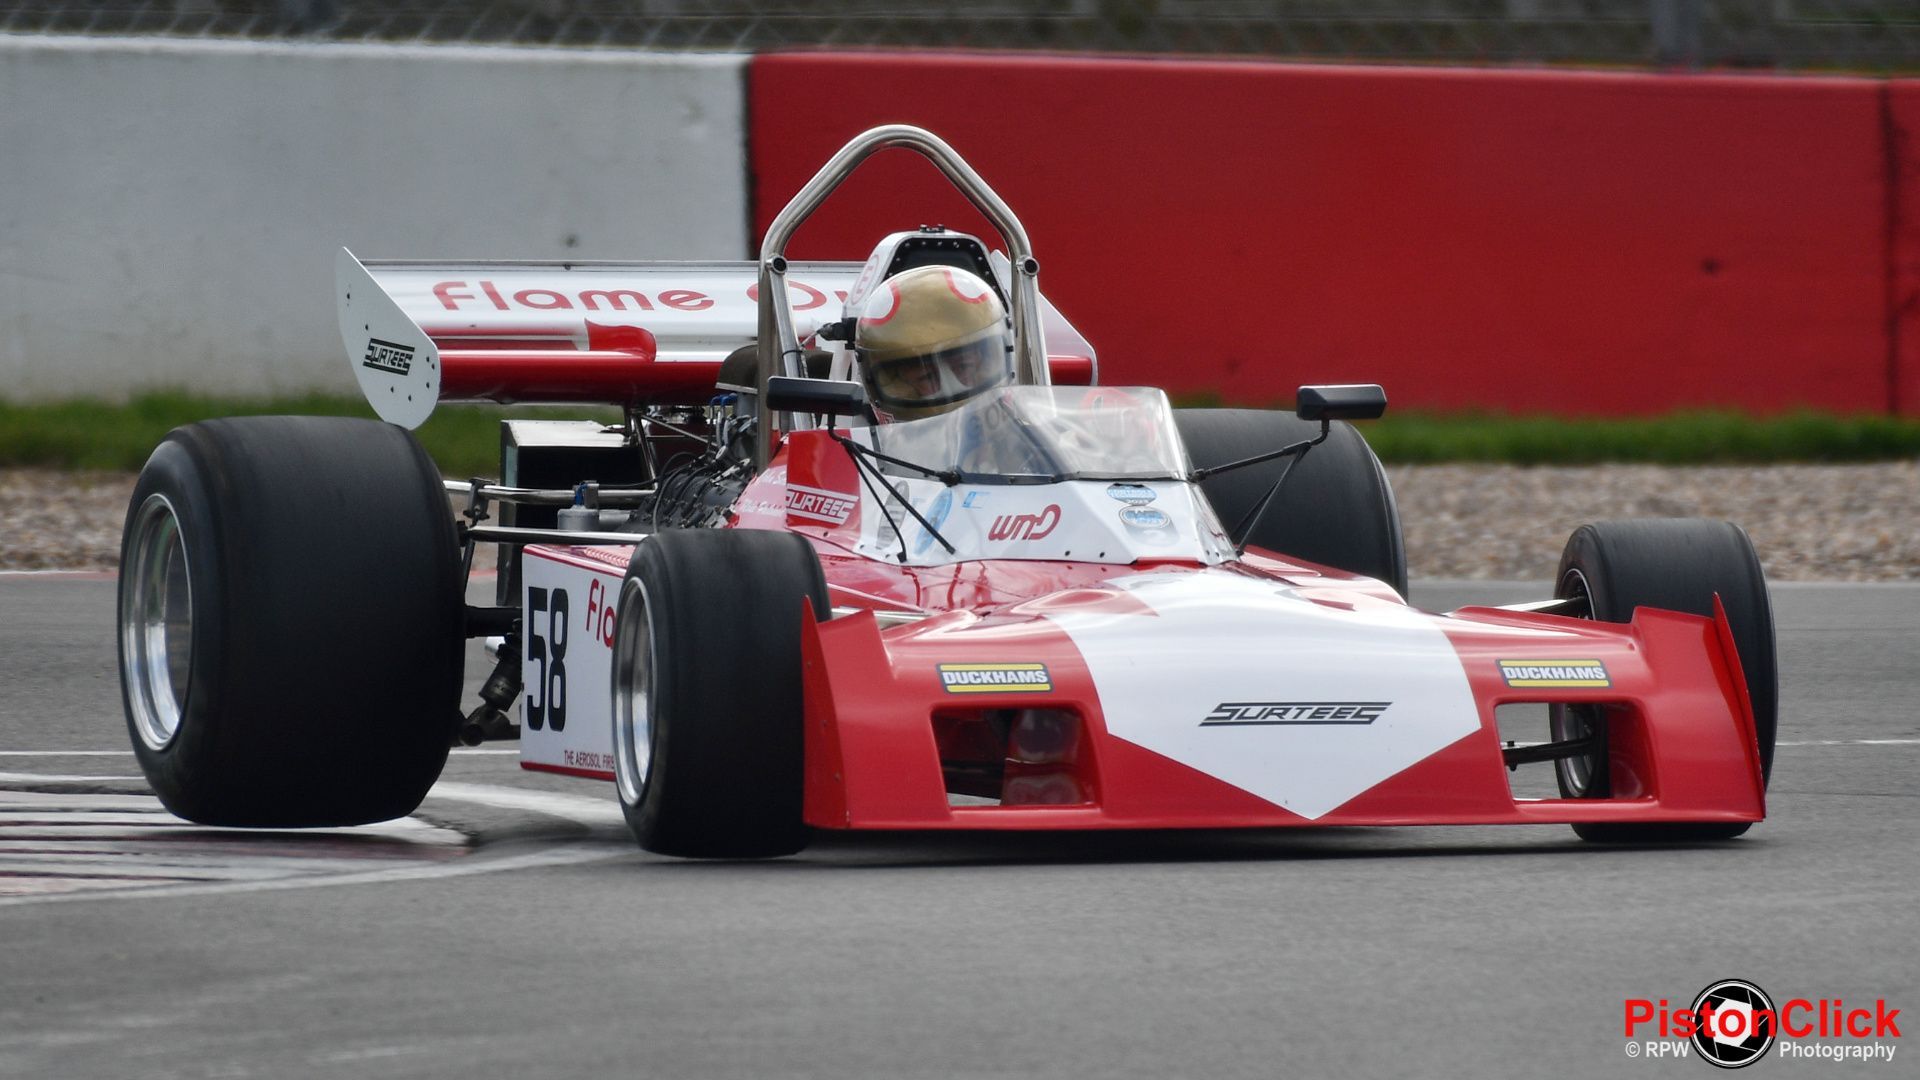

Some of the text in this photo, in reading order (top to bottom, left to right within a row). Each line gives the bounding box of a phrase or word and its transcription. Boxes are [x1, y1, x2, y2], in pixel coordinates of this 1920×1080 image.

[432, 280, 714, 312] Flame
[363, 338, 415, 376] SURTEES
[526, 586, 569, 732] 58
[942, 671, 1048, 684] DUCKHAMS
[1502, 667, 1606, 679] DUCKHAMS
[1198, 702, 1392, 726] SURTEES
[564, 750, 574, 766] THE
[576, 751, 601, 769] AEROSOL
